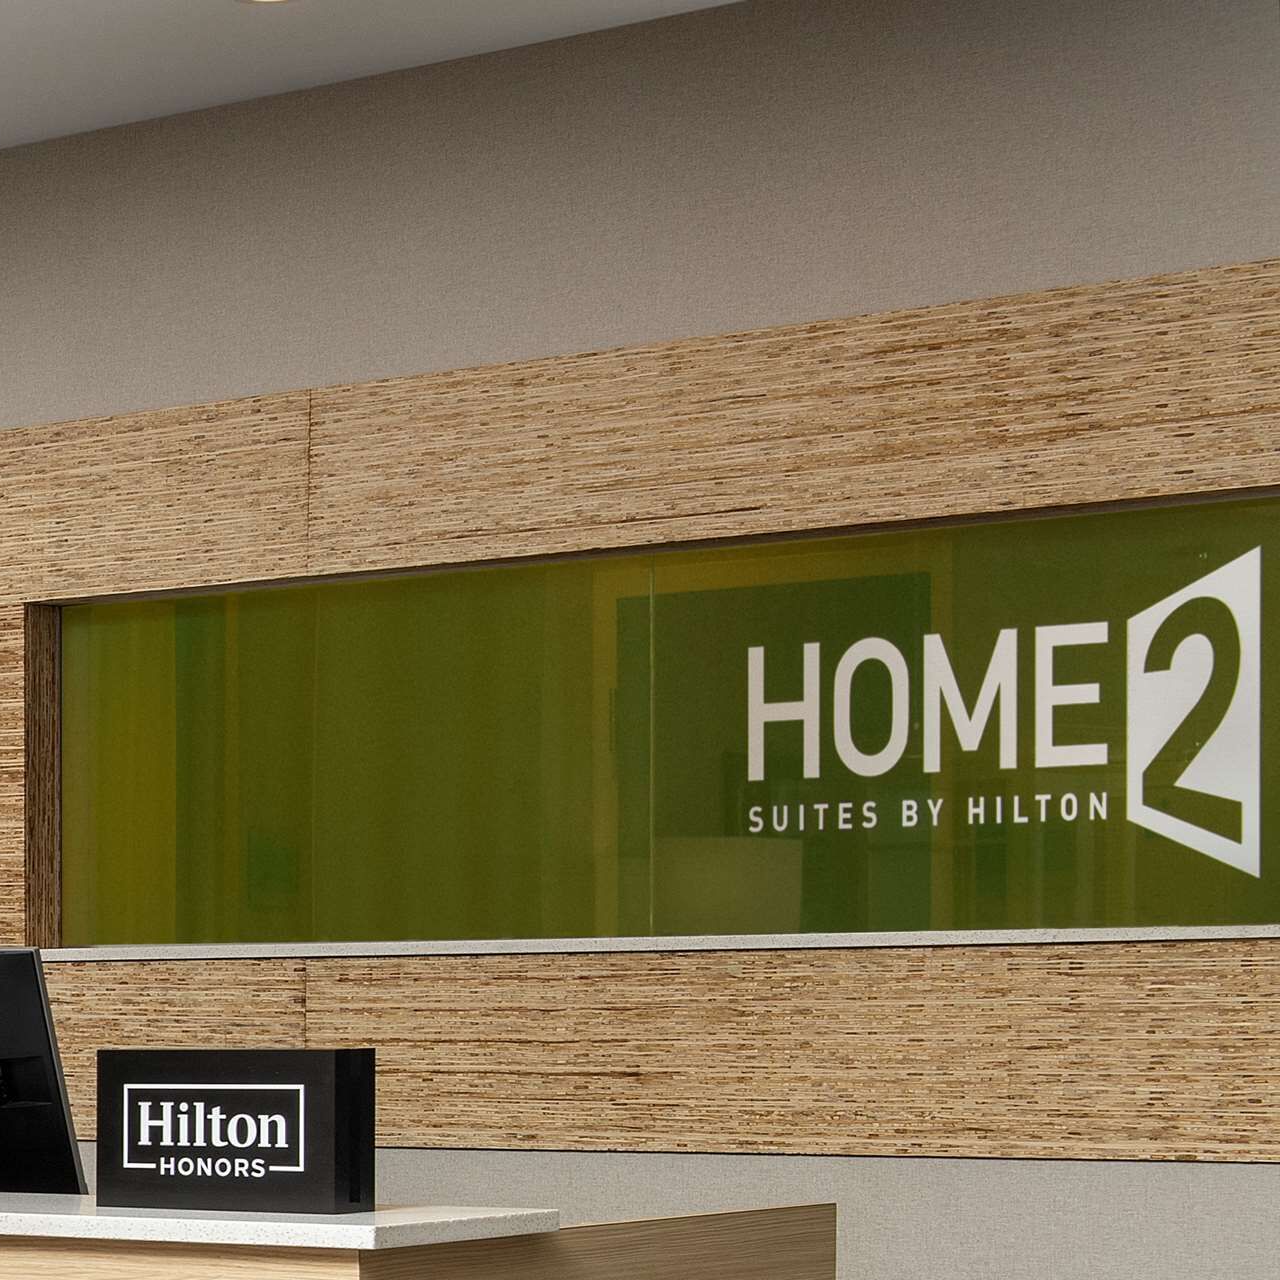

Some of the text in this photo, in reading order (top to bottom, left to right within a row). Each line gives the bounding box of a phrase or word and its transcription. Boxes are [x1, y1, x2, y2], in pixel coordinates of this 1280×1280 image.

[747, 791, 1108, 833] SUITES BY HILTON
[137, 1101, 289, 1148] Hilton
[159, 1156, 266, 1178] HONORS
